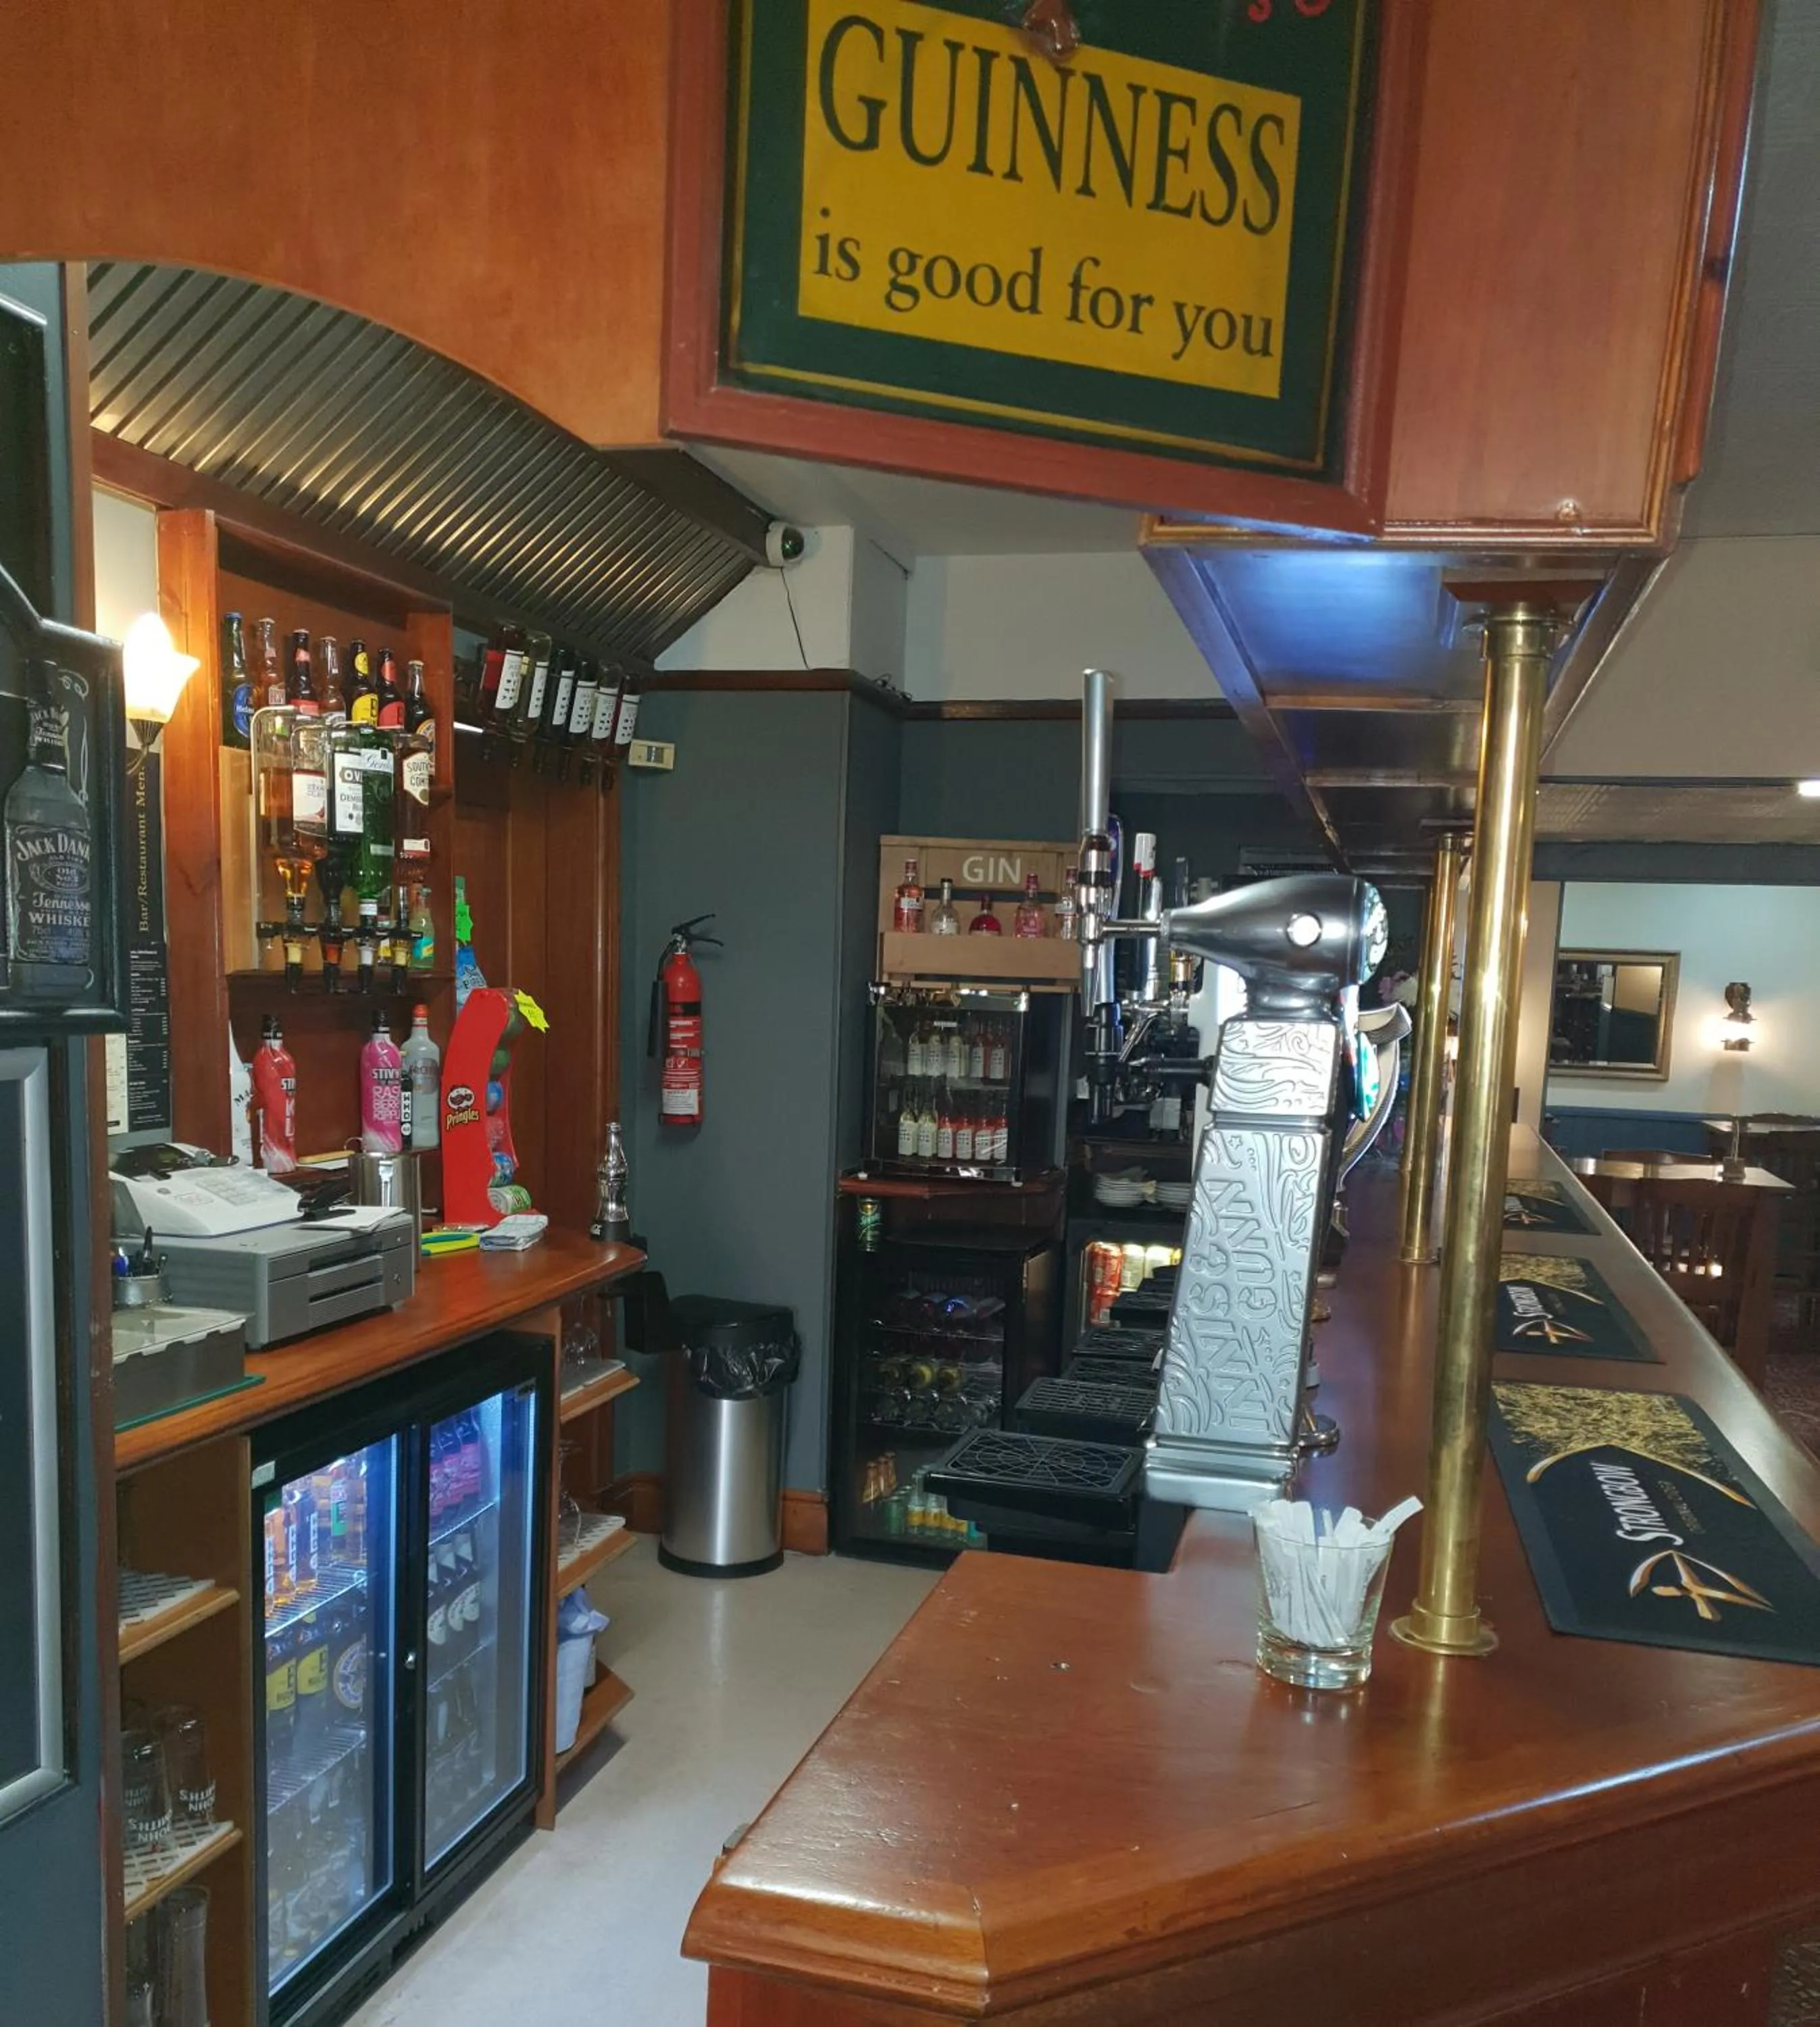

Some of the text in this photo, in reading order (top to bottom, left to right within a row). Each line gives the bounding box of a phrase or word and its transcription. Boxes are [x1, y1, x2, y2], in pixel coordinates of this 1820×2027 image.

[819, 16, 1285, 236] GUINNESS
[815, 207, 1273, 361] is good for you
[16, 832, 91, 862] JACK DANI
[136, 766, 149, 932] Bar/Restaurant Men
[962, 855, 1021, 884] GIN
[28, 911, 91, 927] WHISKE
[447, 1107, 479, 1131] Pringles
[1203, 1180, 1277, 1320] GUNN
[1188, 1282, 1269, 1431] INNIS
[1589, 1459, 1684, 1546] STRONGBOW
